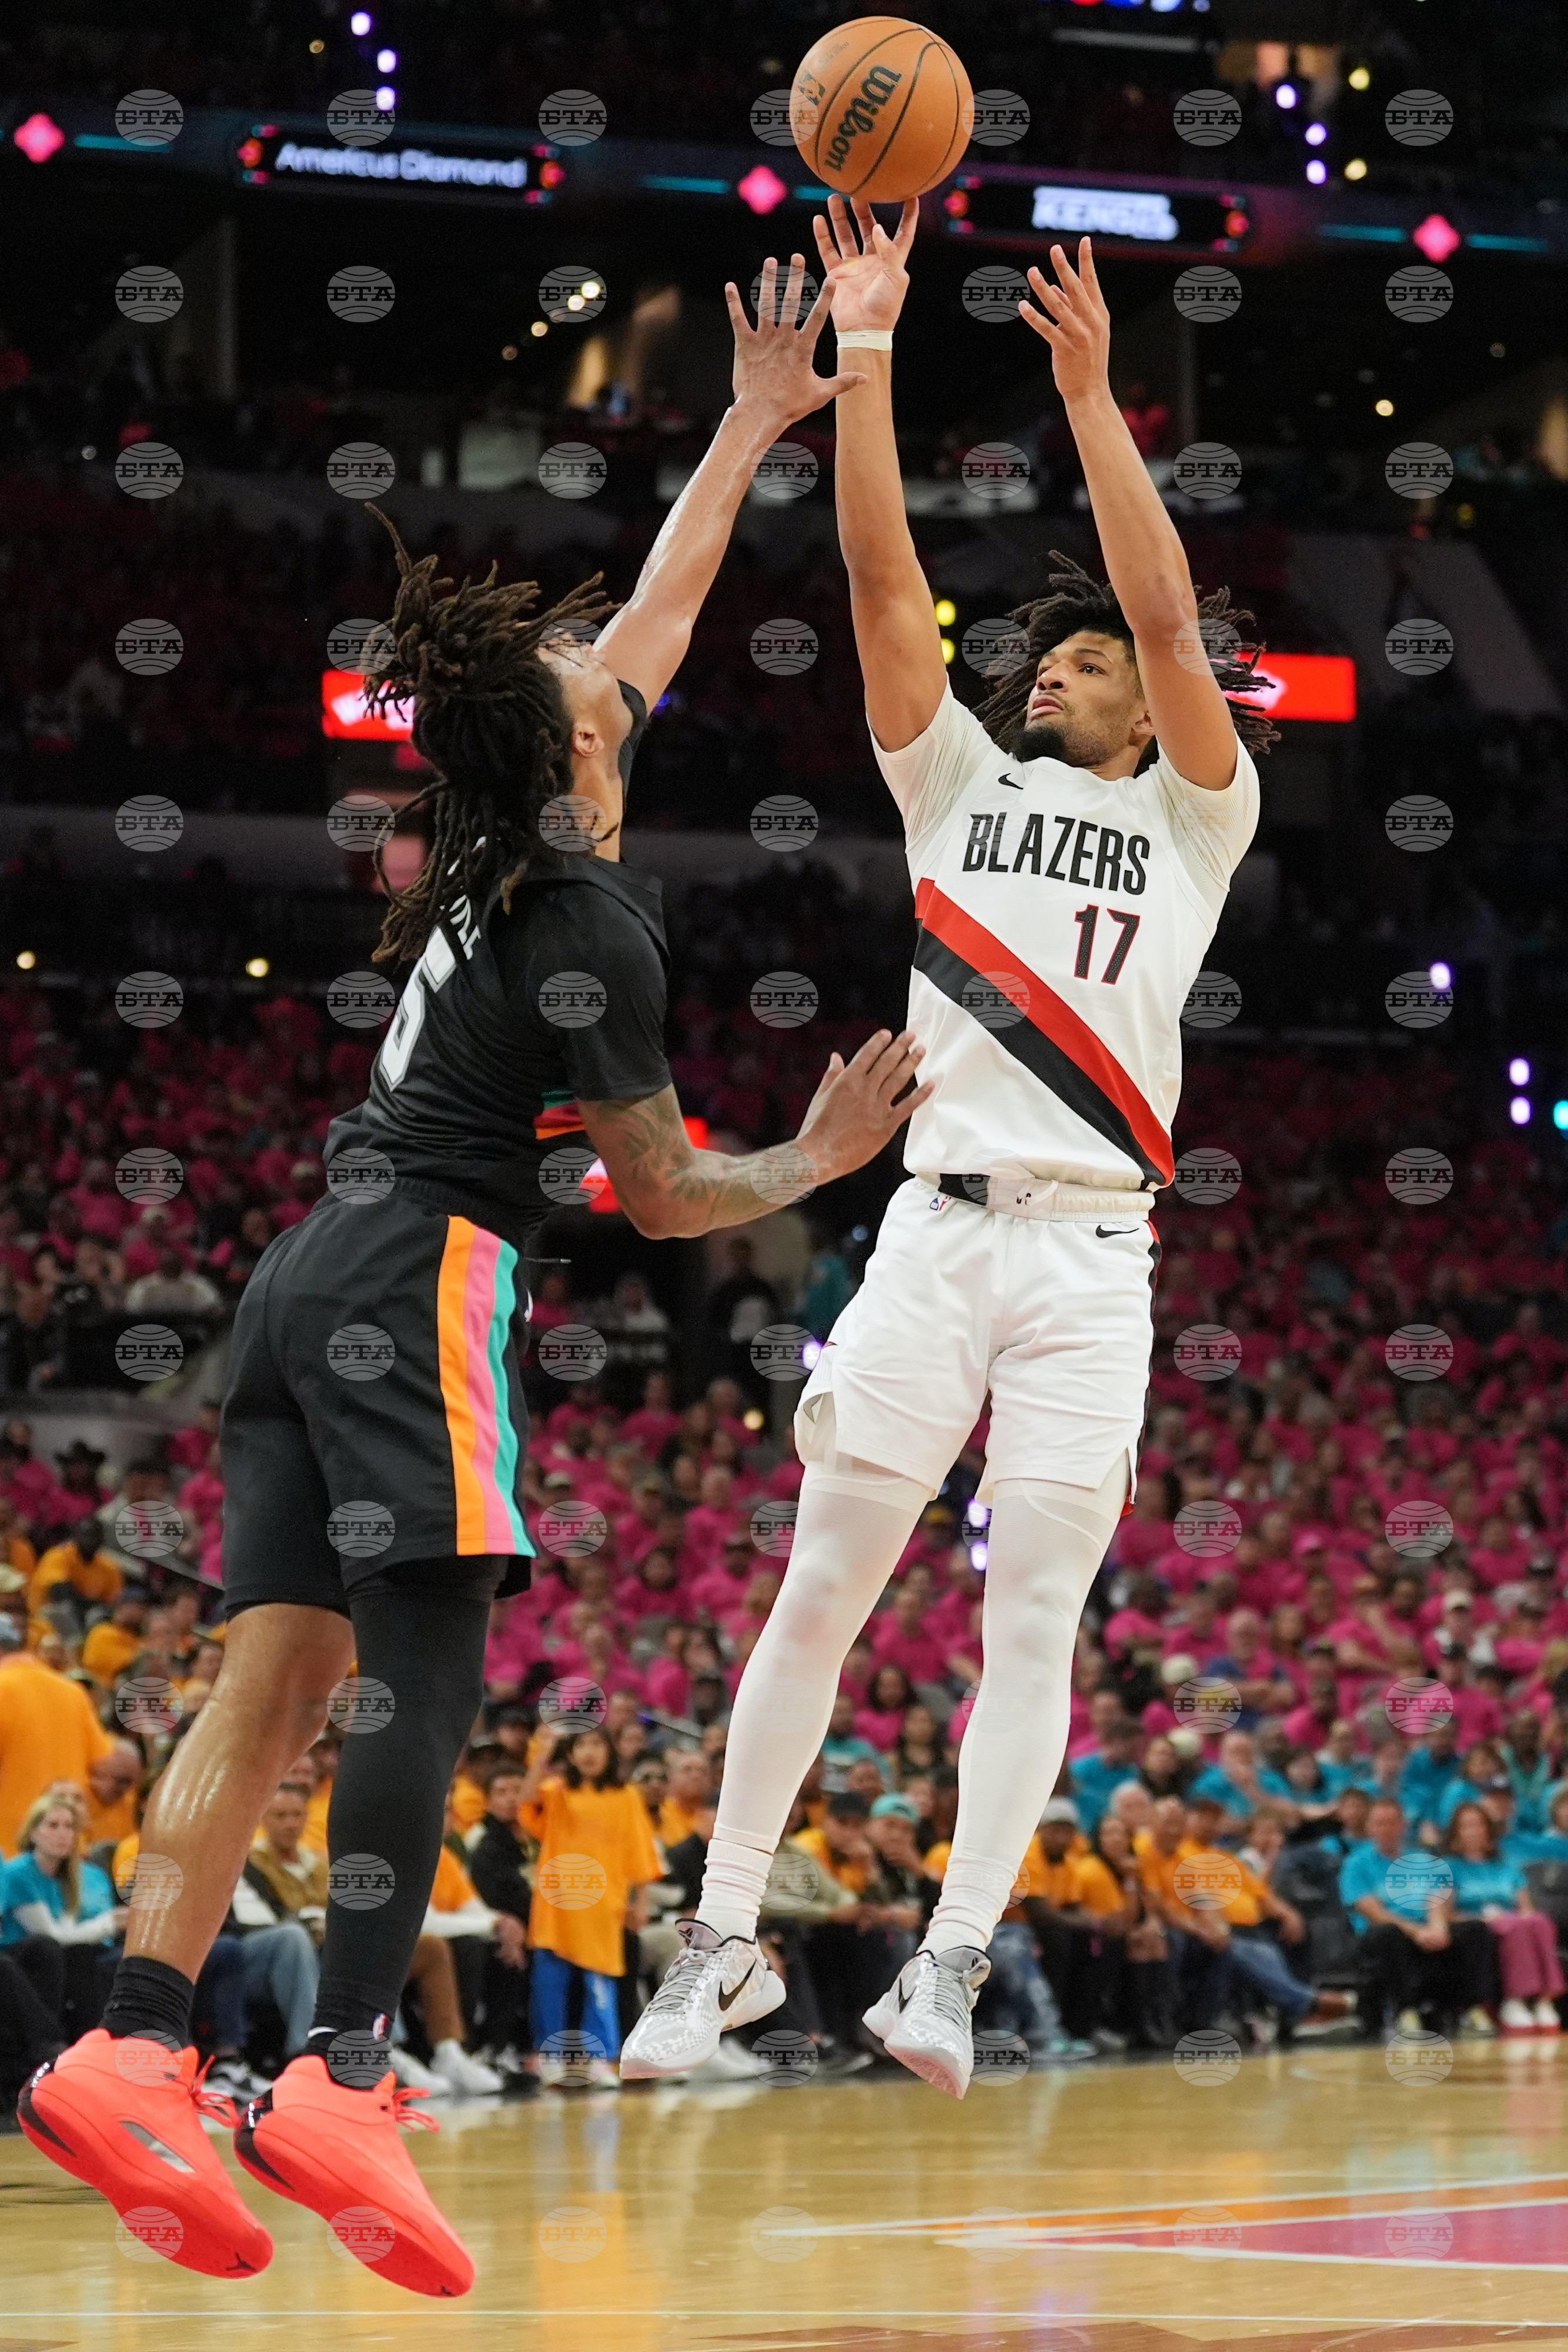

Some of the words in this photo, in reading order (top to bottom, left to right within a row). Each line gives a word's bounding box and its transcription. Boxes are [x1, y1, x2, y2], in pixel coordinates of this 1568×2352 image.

[825, 65, 902, 171] Wilson
[962, 812, 1150, 895] BLAZERS
[1074, 904, 1141, 985] 17
